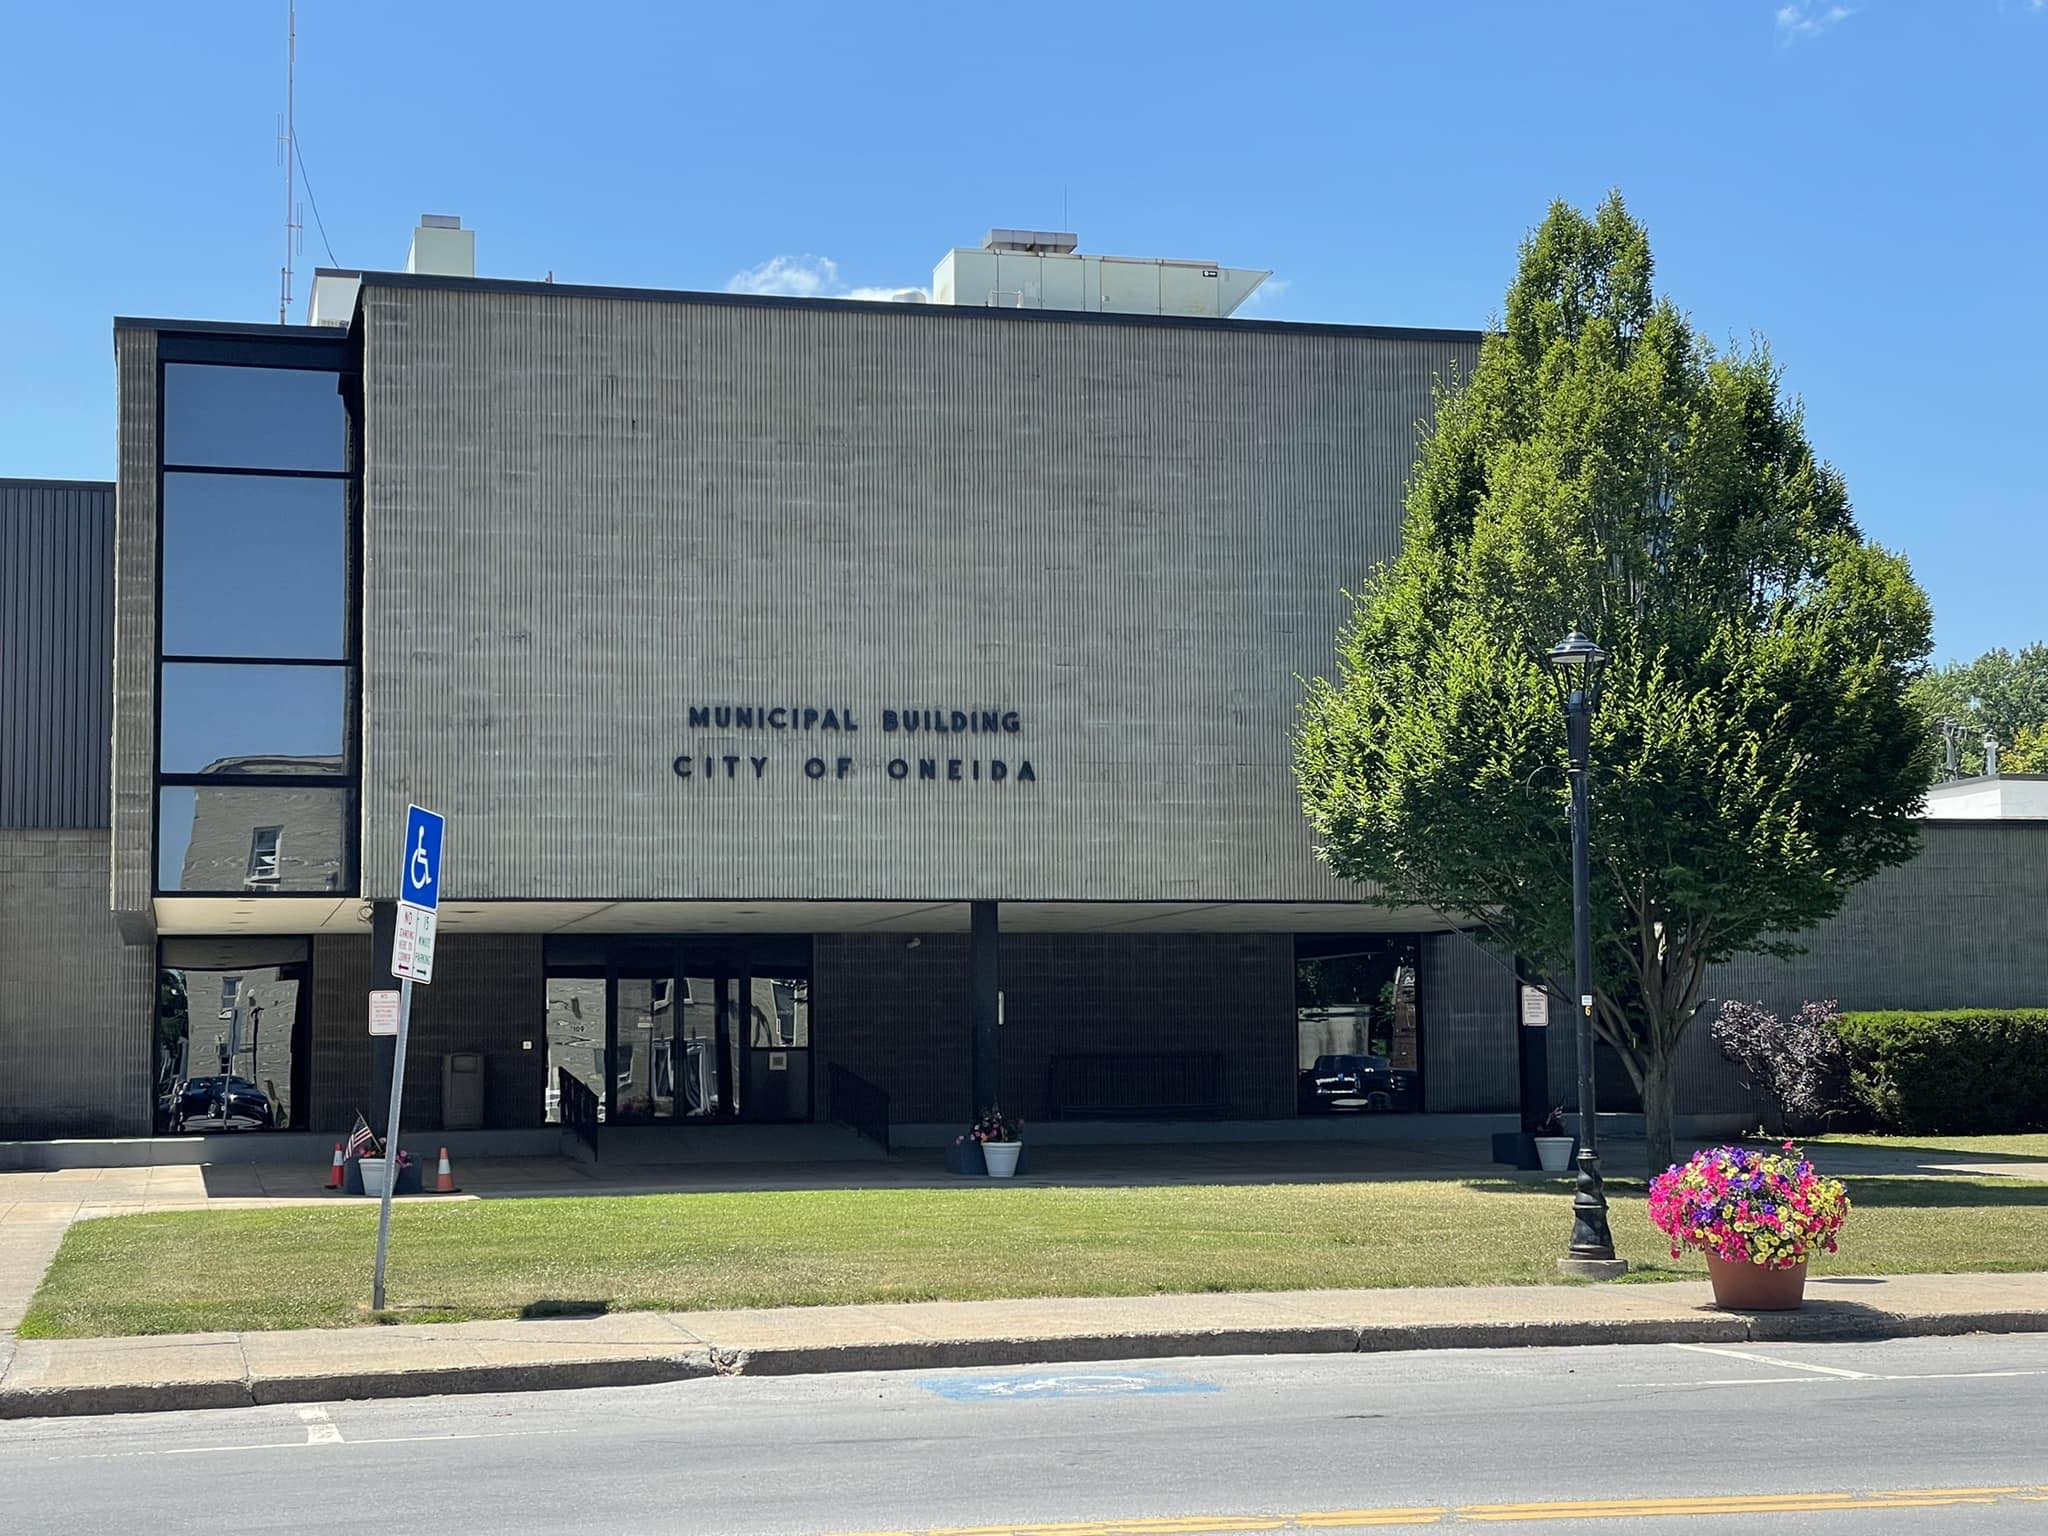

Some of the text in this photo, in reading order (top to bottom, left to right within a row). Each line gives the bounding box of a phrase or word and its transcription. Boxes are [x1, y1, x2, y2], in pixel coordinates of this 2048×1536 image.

[688, 706, 1020, 733] MUNICIPAL BUILDING
[673, 755, 1036, 782] CITY OF ONEIDA
